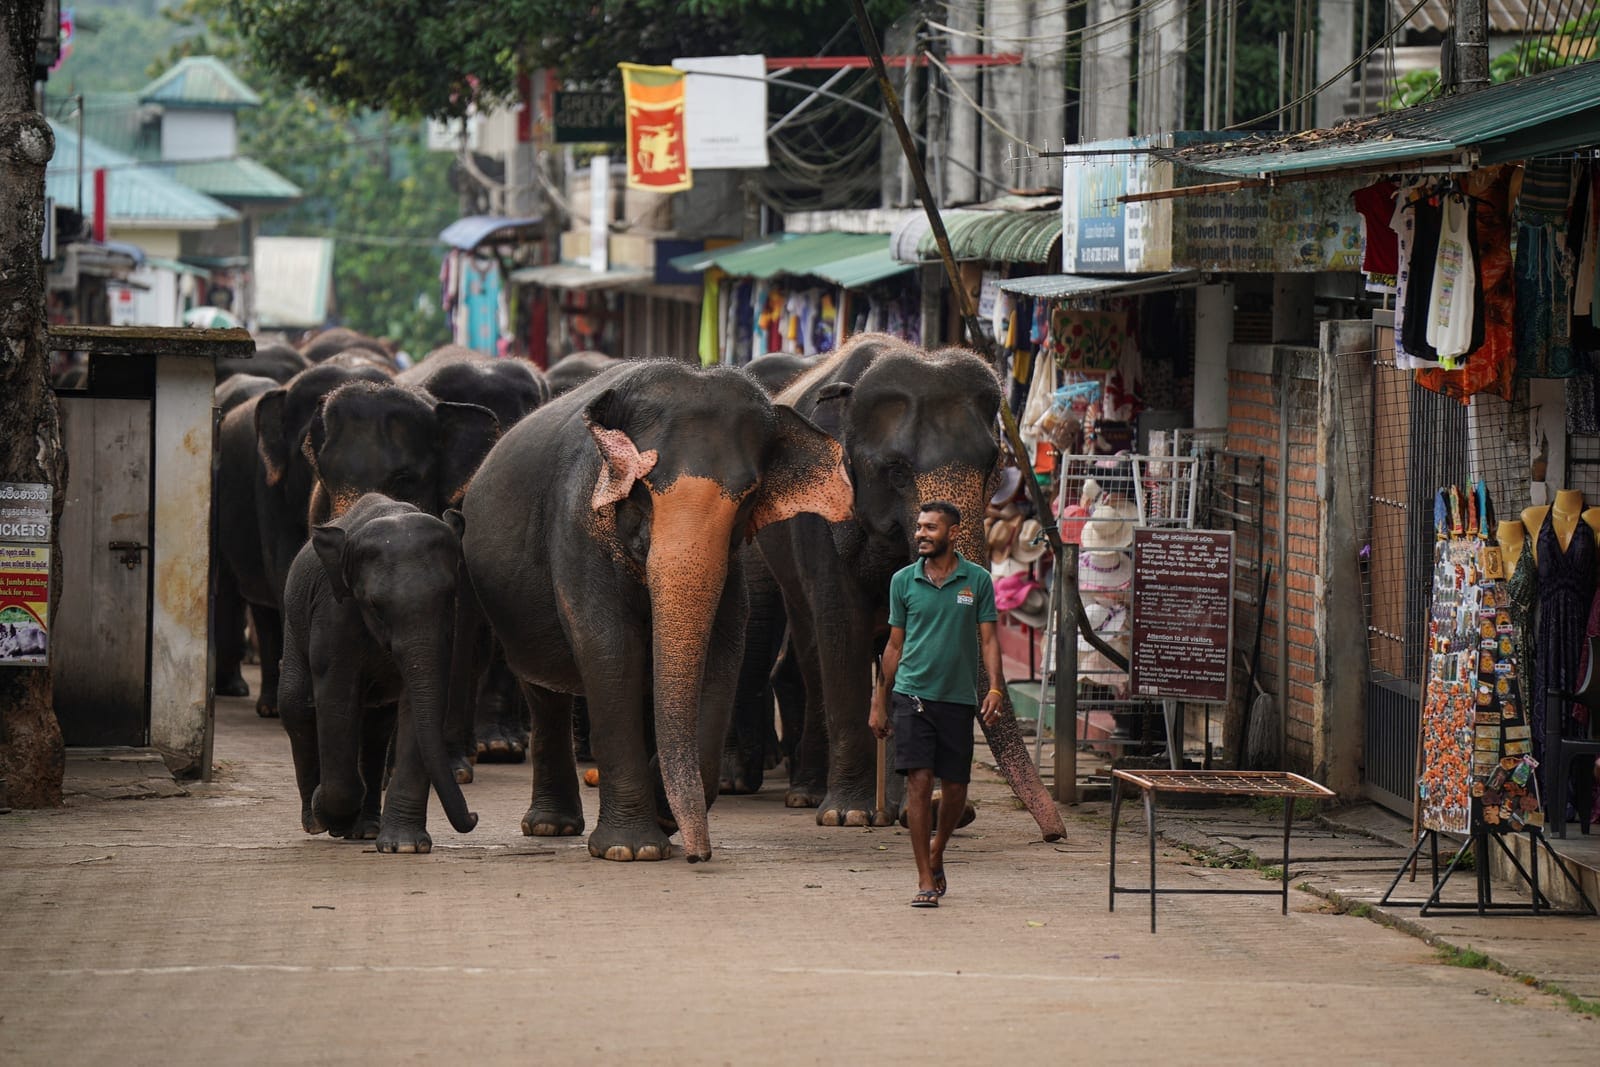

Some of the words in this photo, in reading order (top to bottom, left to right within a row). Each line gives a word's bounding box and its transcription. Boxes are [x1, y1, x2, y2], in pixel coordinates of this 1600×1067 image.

[1186, 224, 1217, 239] Velvet
[1220, 224, 1257, 239] Picture
[0, 524, 46, 537] ICKETS
[6, 578, 24, 586] Jumbo
[26, 578, 48, 588] Bathing
